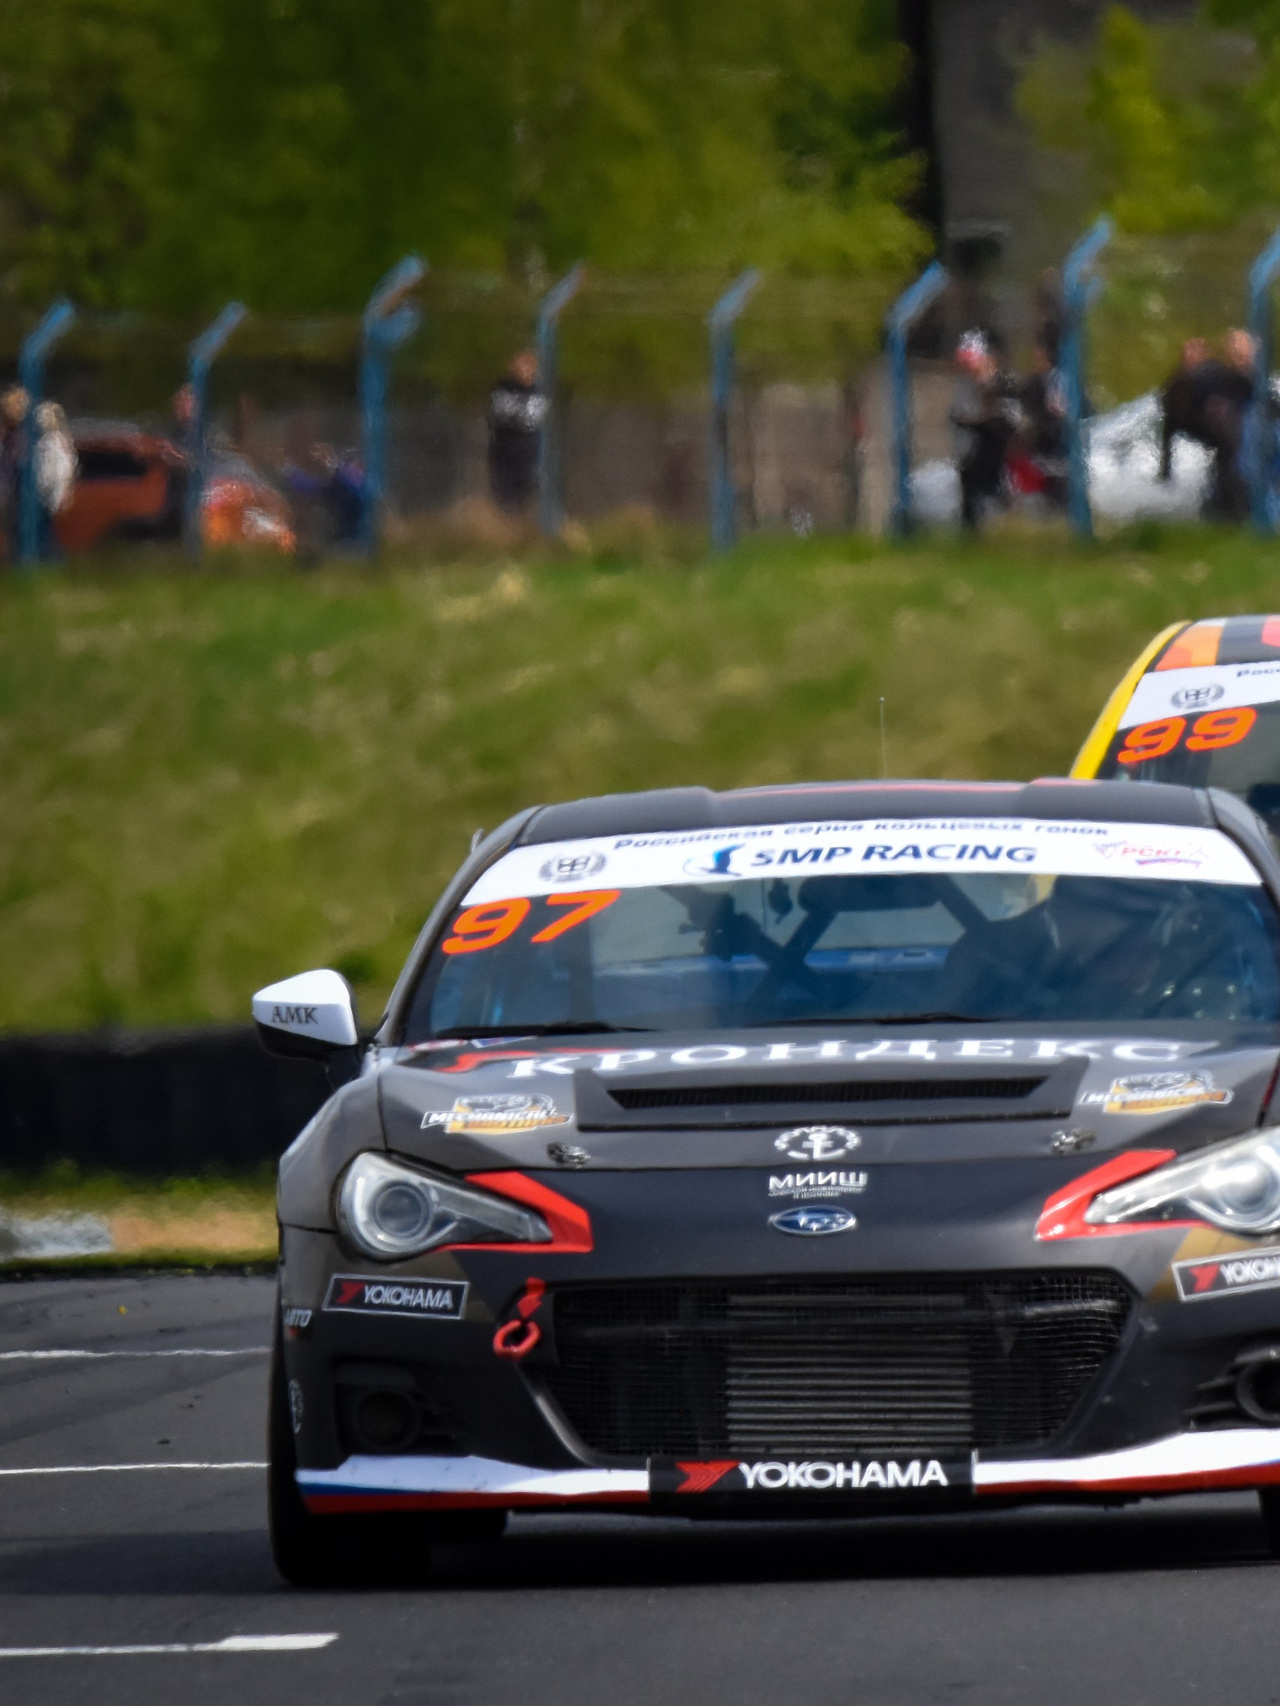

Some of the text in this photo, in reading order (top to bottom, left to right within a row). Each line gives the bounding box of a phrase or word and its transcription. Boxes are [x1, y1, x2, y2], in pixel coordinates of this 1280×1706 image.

[1116, 706, 1258, 764] 99
[750, 844, 1038, 867] SMP RACING
[442, 889, 622, 955] 97
[507, 1039, 1181, 1079] КРОНДЕКС
[768, 1171, 869, 1190] МИИШ
[363, 1284, 454, 1310] YOKOHAMA
[737, 1459, 949, 1489] YOKOHAMA
